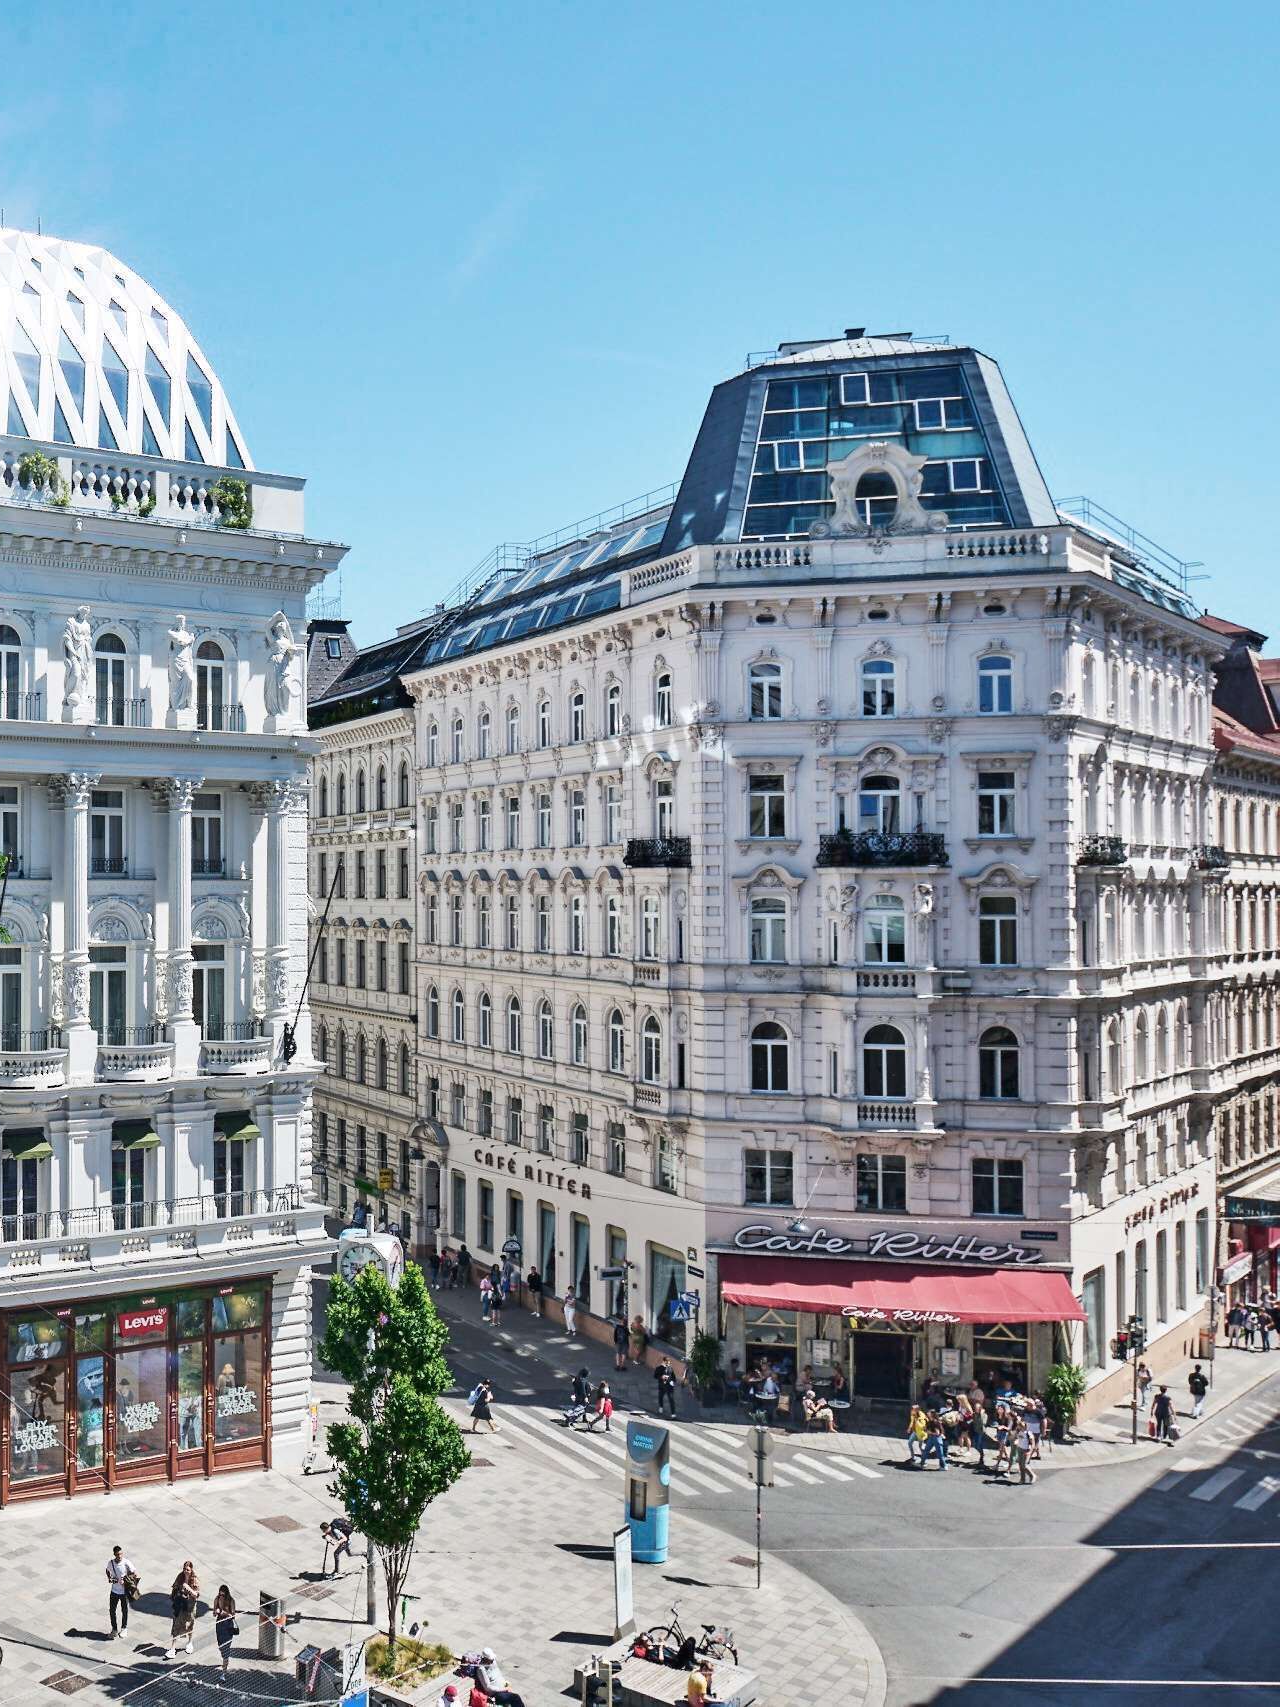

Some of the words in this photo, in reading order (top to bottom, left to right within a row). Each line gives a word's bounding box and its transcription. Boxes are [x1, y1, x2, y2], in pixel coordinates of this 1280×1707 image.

[474, 1149, 516, 1174] CAFÉ
[524, 1165, 591, 1200] RITTER
[734, 1225, 852, 1253] Cafe
[870, 1231, 1042, 1264] Ritter
[841, 1305, 888, 1320] Cafe
[893, 1309, 960, 1323] Ritter
[14, 1439, 60, 1454] LONGER.
